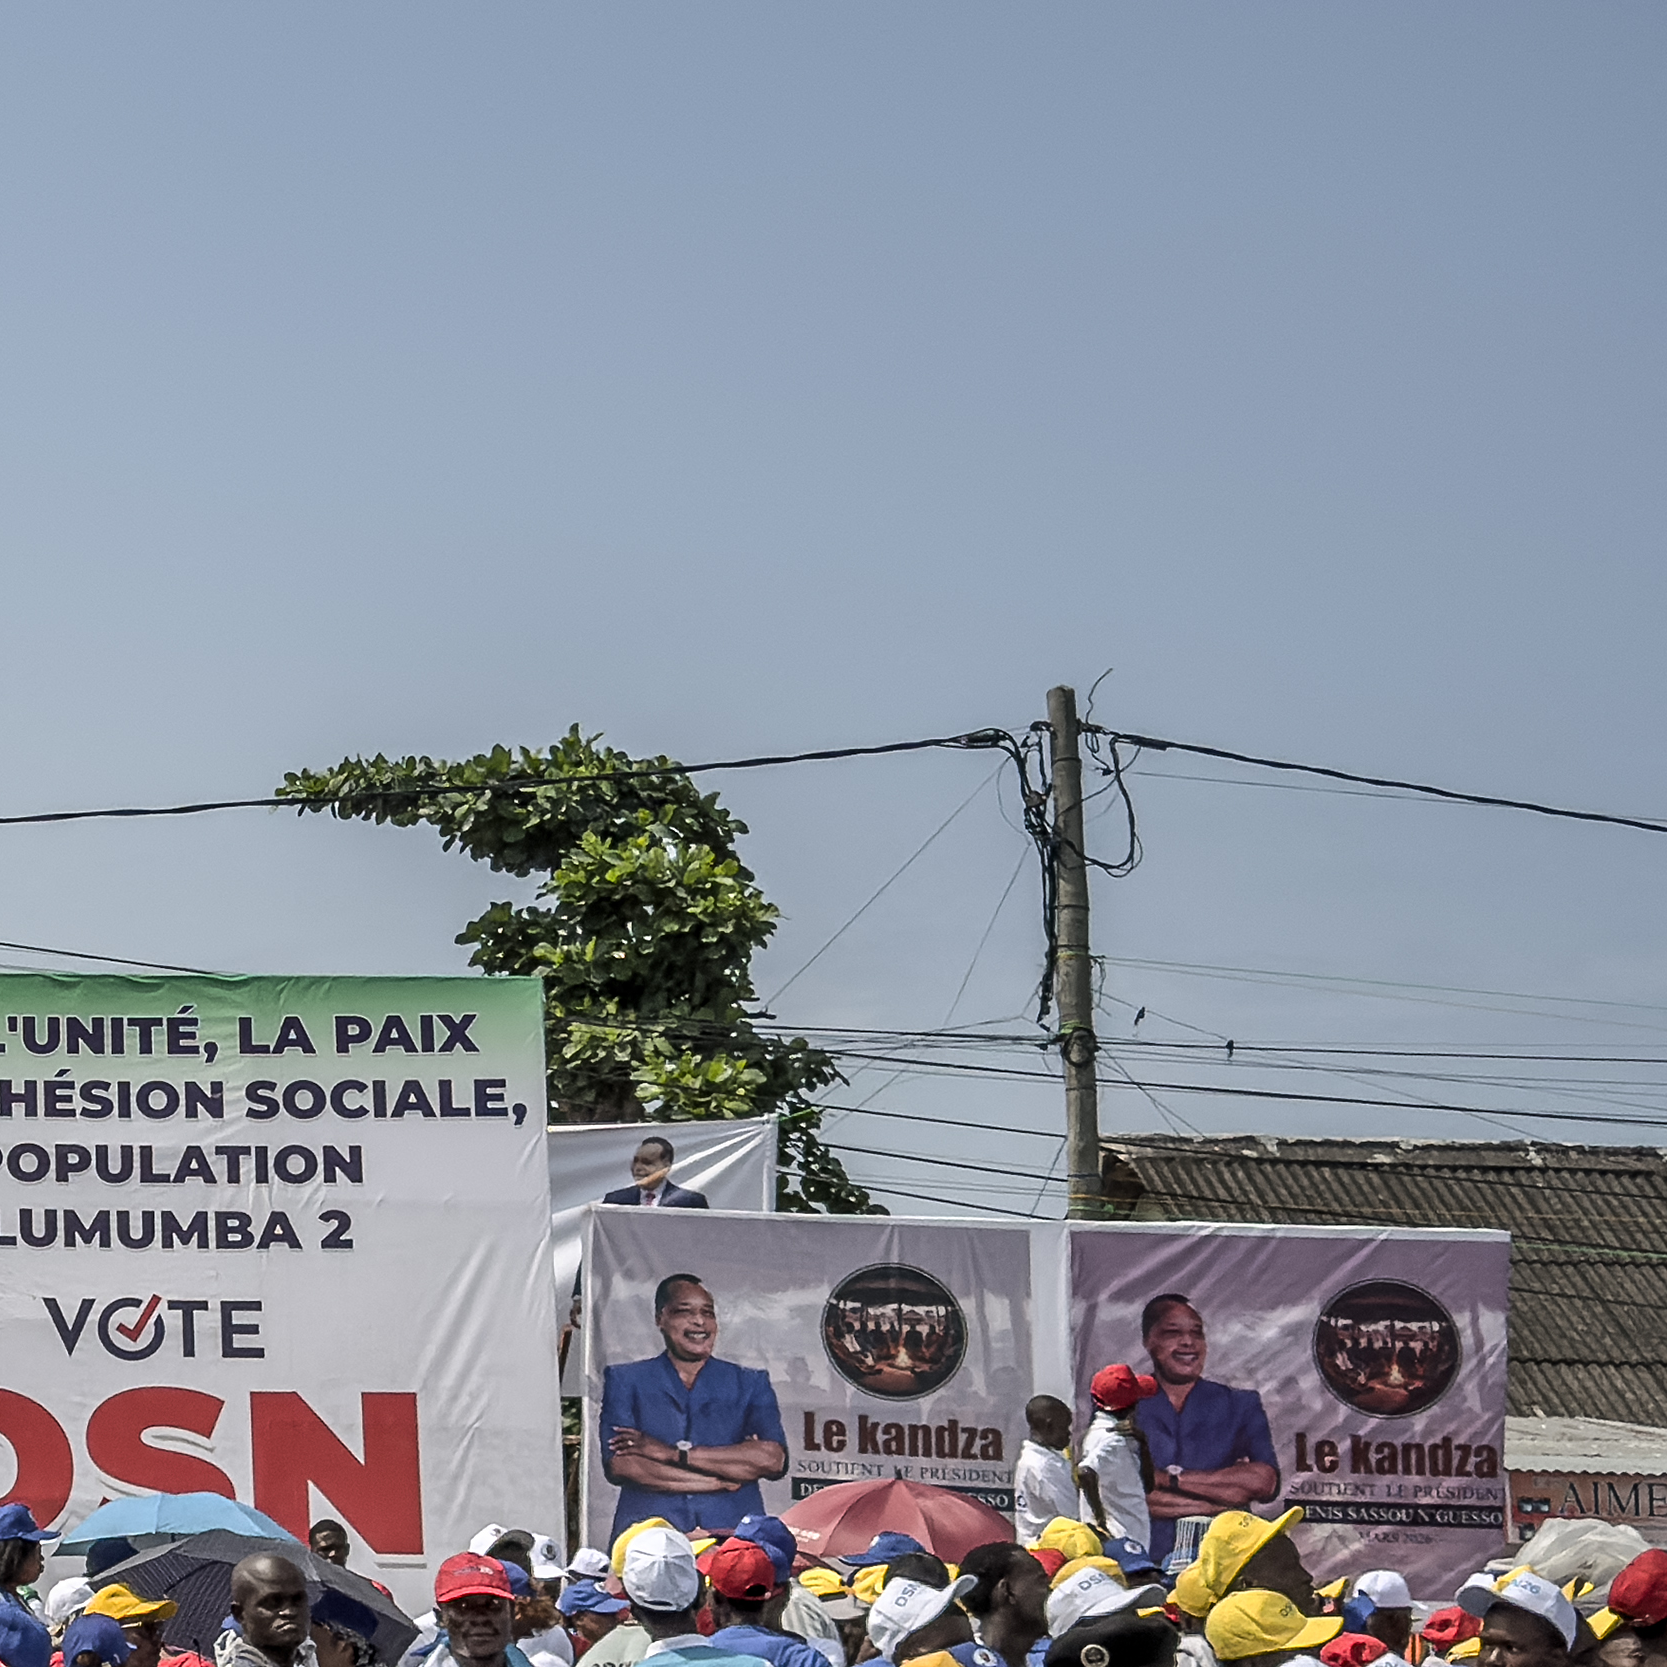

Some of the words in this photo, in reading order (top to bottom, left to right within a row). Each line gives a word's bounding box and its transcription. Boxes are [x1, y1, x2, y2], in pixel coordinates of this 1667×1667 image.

[238, 1016, 317, 1056] LA
[334, 1013, 480, 1055] PAIX
[245, 1077, 528, 1126] SOCIALE,
[319, 1209, 354, 1250] 2
[41, 1293, 265, 1362] VOTE
[803, 1410, 848, 1453] Le
[857, 1415, 1005, 1462] kandza
[1295, 1432, 1340, 1473] Le
[1349, 1434, 1499, 1479] kandza
[797, 1459, 884, 1479] SOUTIENT
[1289, 1481, 1375, 1498] SOUTIENT
[1304, 1505, 1343, 1520] ENIS
[1347, 1507, 1415, 1522] SASSOU
